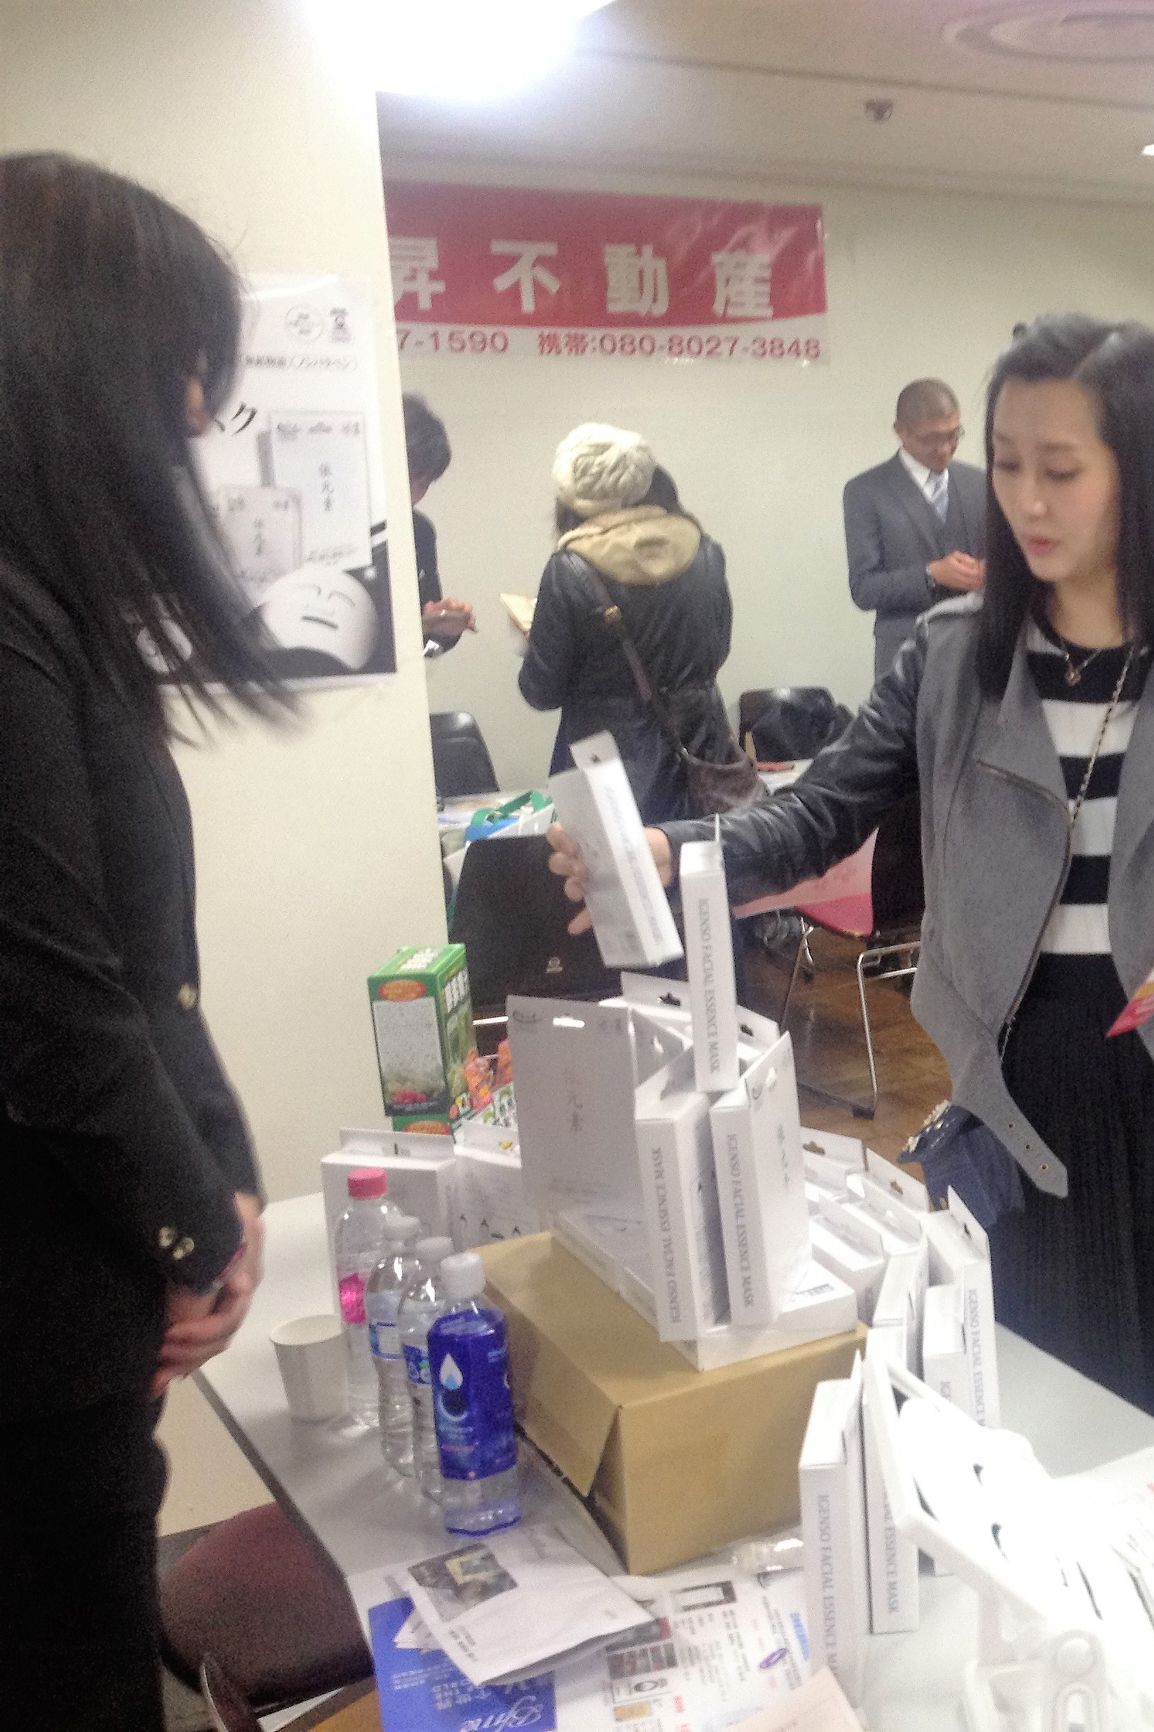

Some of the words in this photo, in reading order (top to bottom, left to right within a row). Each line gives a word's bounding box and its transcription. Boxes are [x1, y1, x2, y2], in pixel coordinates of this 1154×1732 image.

[704, 989, 719, 1039] ESSENCE
[654, 1183, 671, 1233] ESSENCE
[732, 1179, 746, 1220] FACIAL
[736, 1223, 752, 1273] ESSENCE
[820, 1545, 835, 1593] FACIAL
[885, 1526, 899, 1578] ESSENCE
[823, 1596, 838, 1649] ESSENCE
[888, 1581, 900, 1615] MASK
